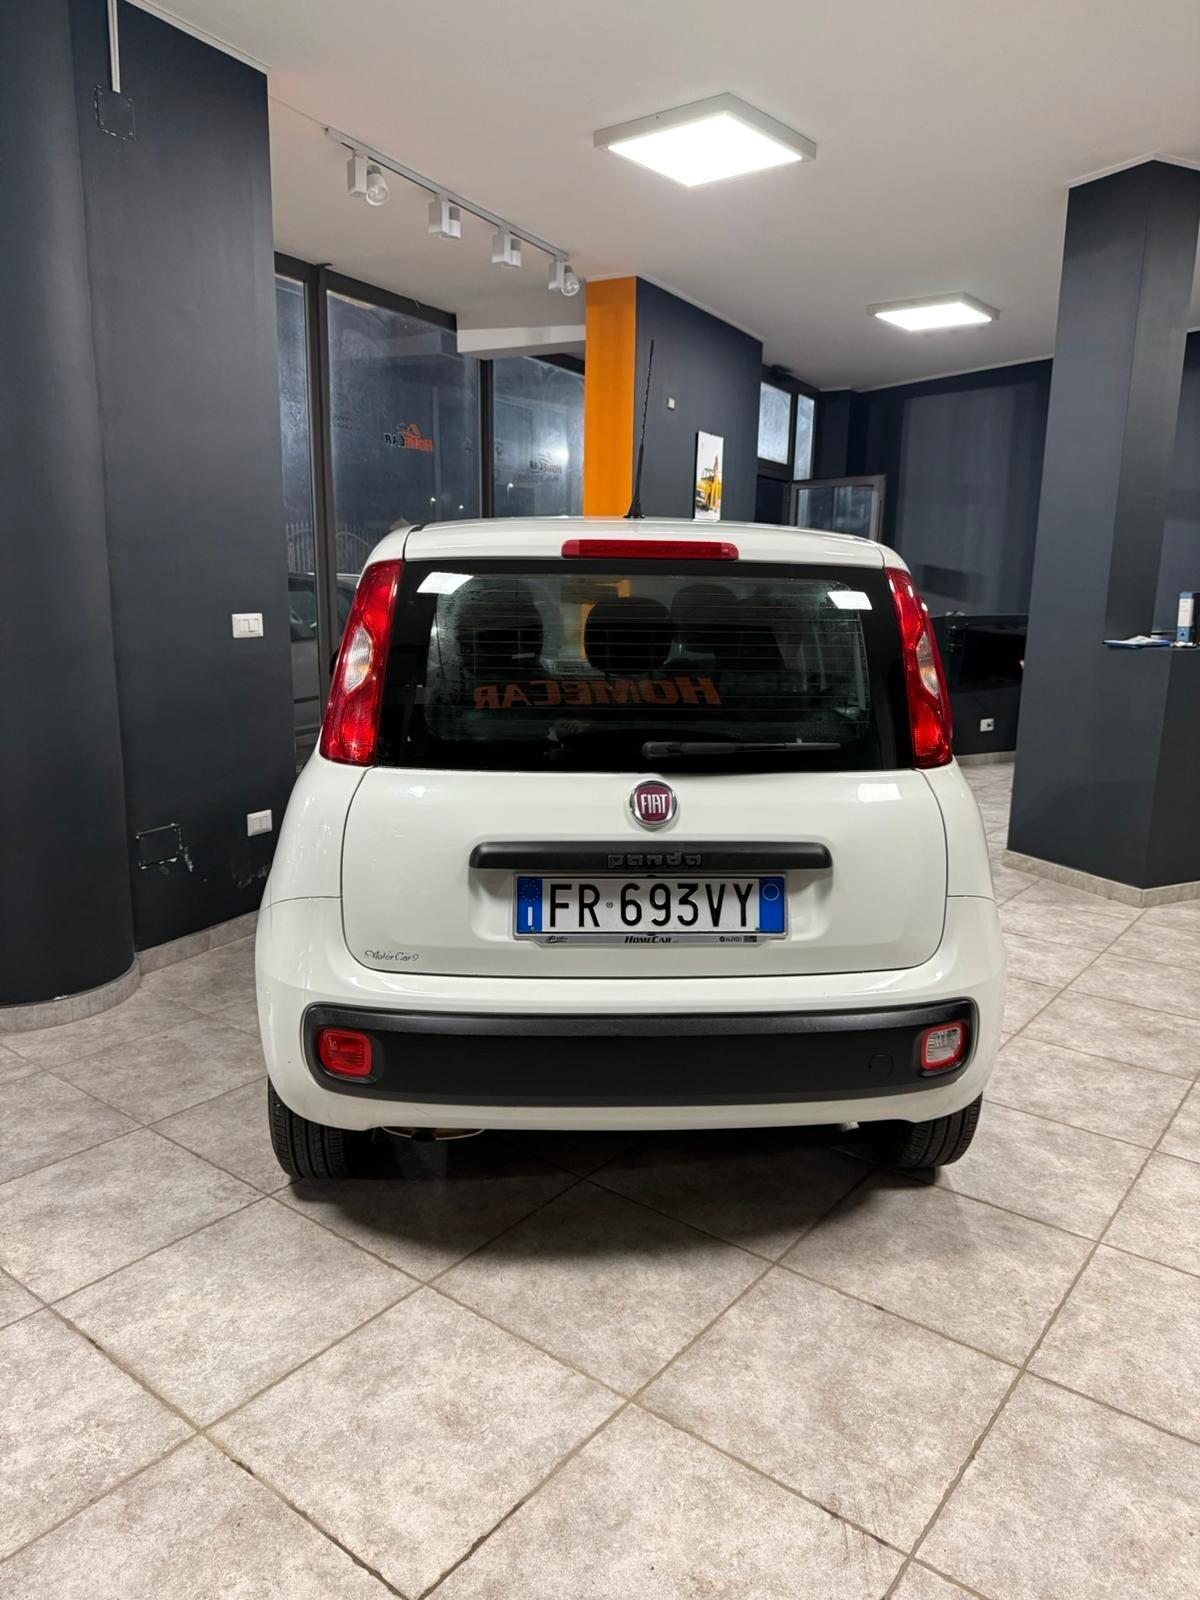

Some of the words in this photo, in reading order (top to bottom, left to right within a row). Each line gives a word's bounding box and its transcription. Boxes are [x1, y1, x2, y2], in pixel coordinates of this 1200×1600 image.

[640, 793, 668, 814] FIAT
[549, 883, 600, 928] FR
[620, 882, 755, 928] 693VY
